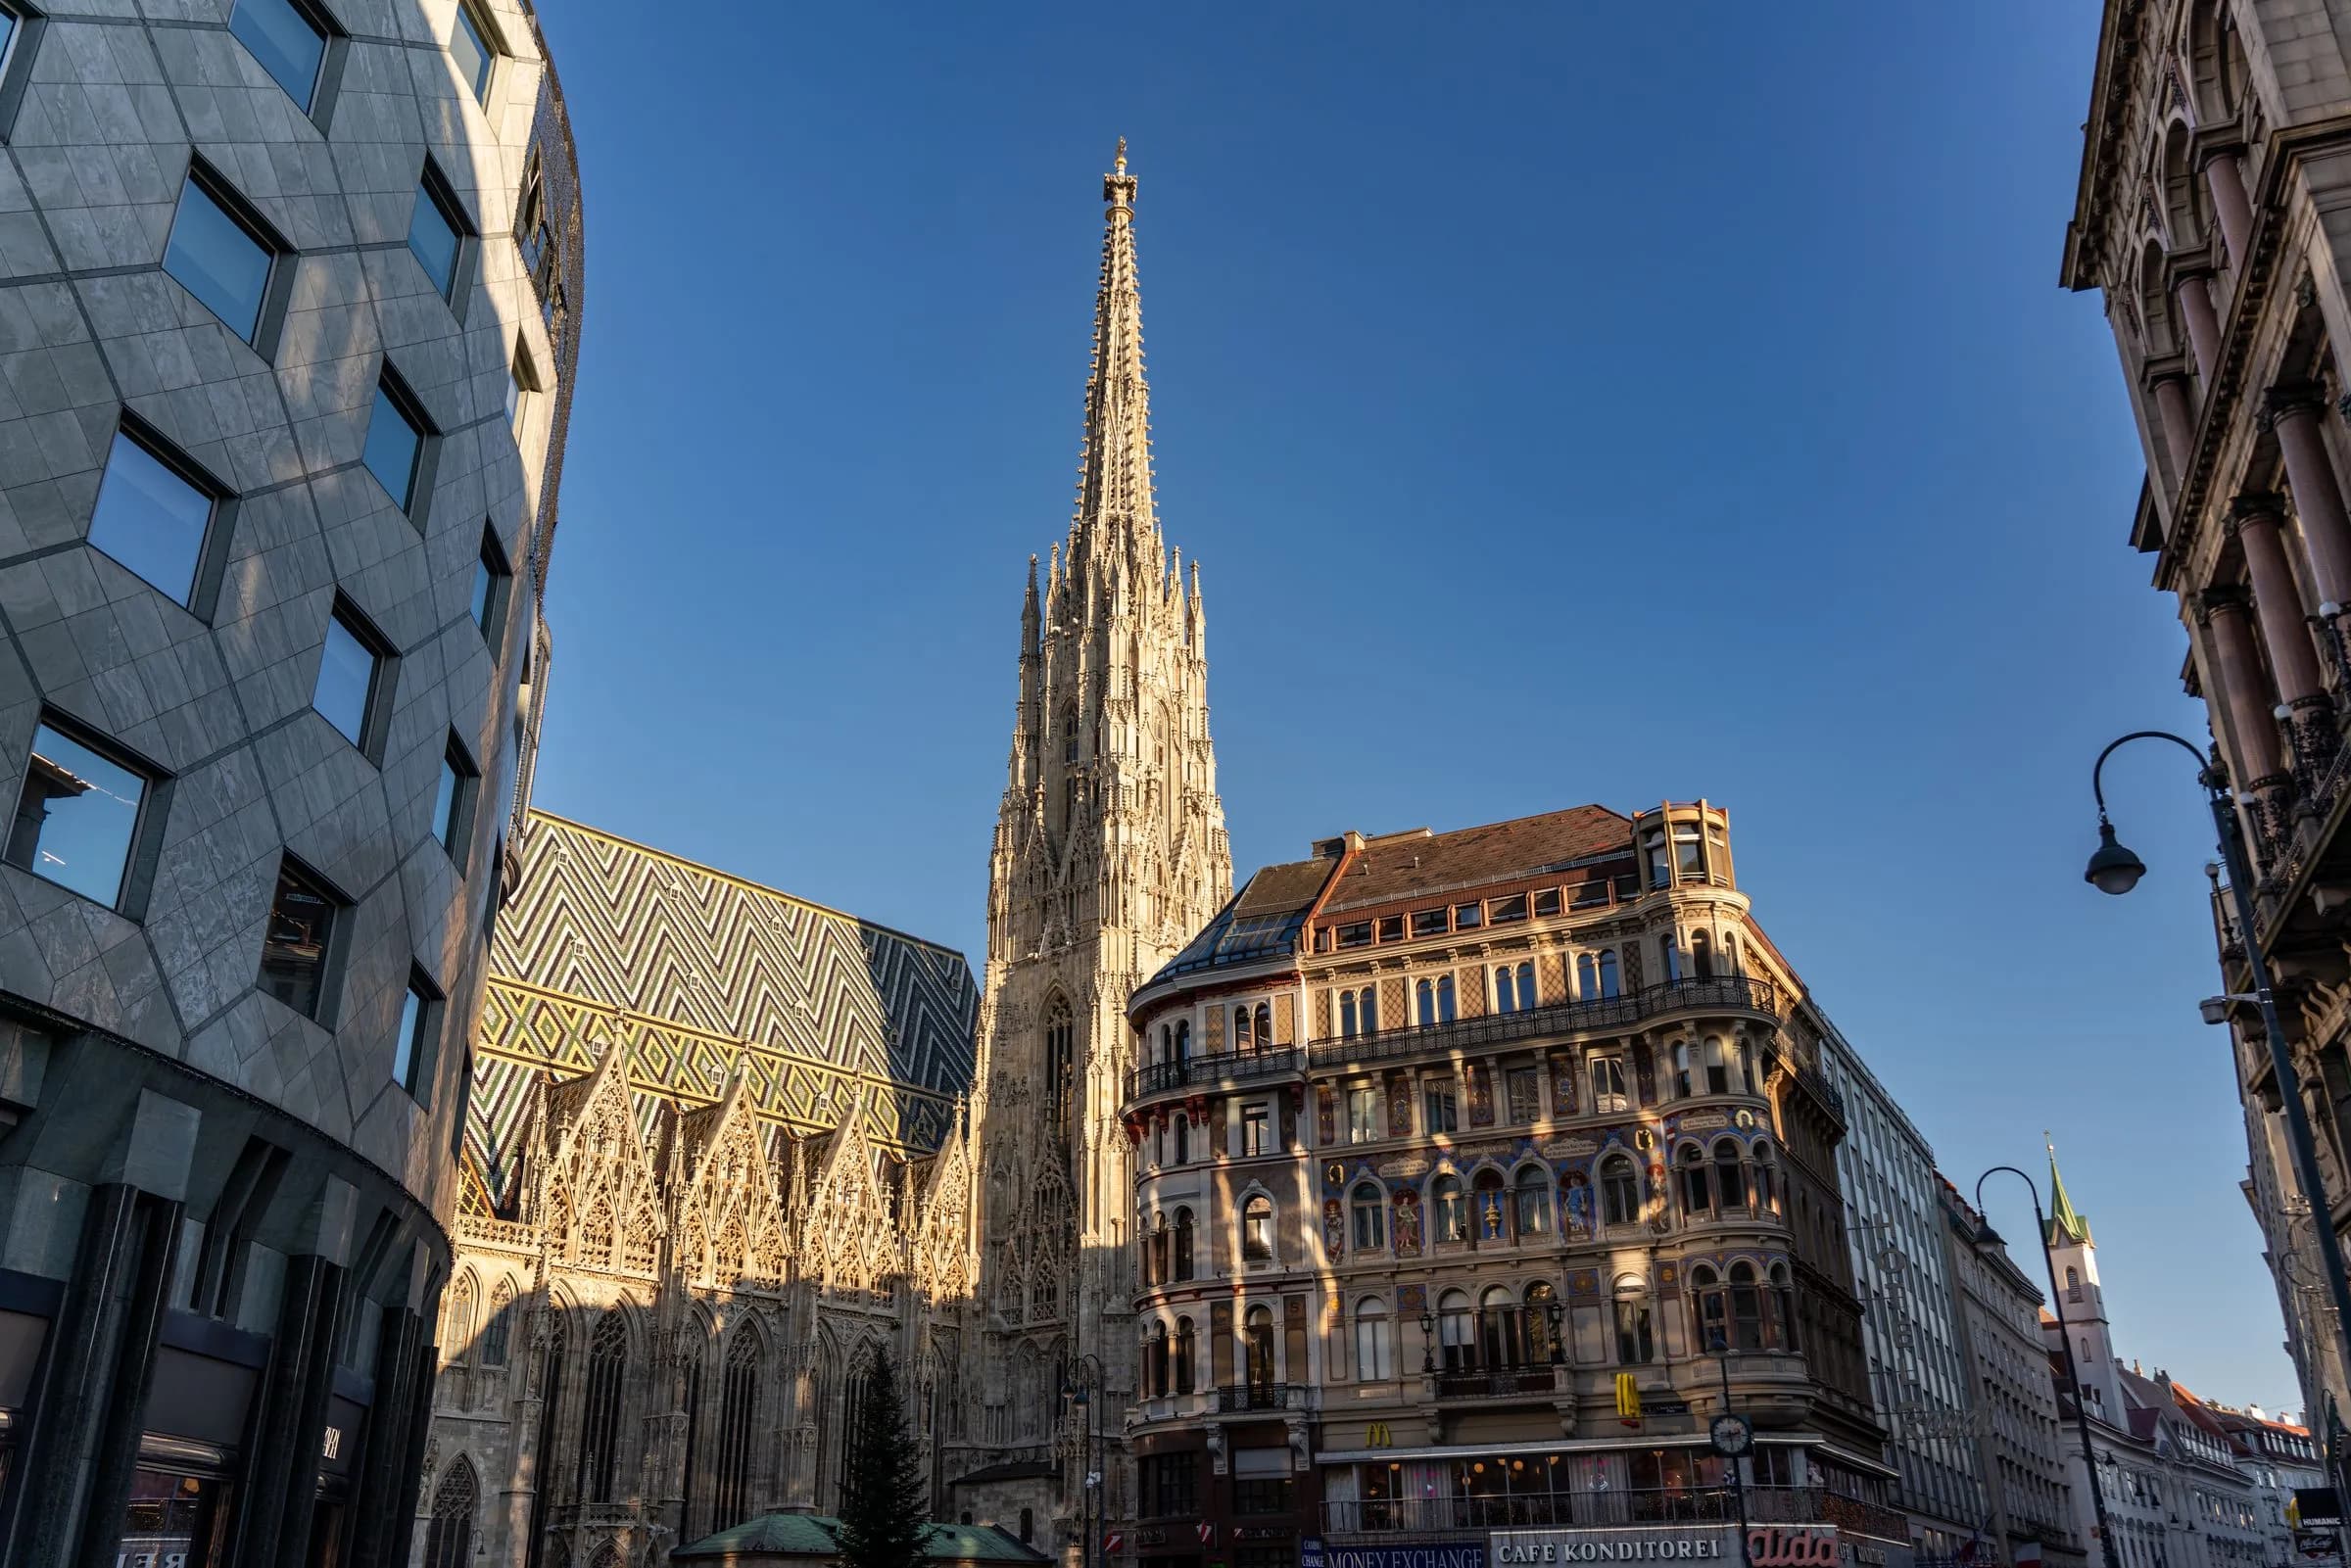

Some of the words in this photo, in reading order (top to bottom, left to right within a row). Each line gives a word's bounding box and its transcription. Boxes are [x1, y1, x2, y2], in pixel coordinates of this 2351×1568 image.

[1873, 1212, 1920, 1386] HOTEL
[1897, 1399, 1997, 1453] Royal
[2303, 1517, 2341, 1526] HUMANIC
[1301, 1554, 1324, 1568] CHANGE
[1328, 1551, 1386, 1568] MONEY
[1391, 1549, 1482, 1568] EXCHANGE
[1563, 1539, 1720, 1562] KONDITOREI
